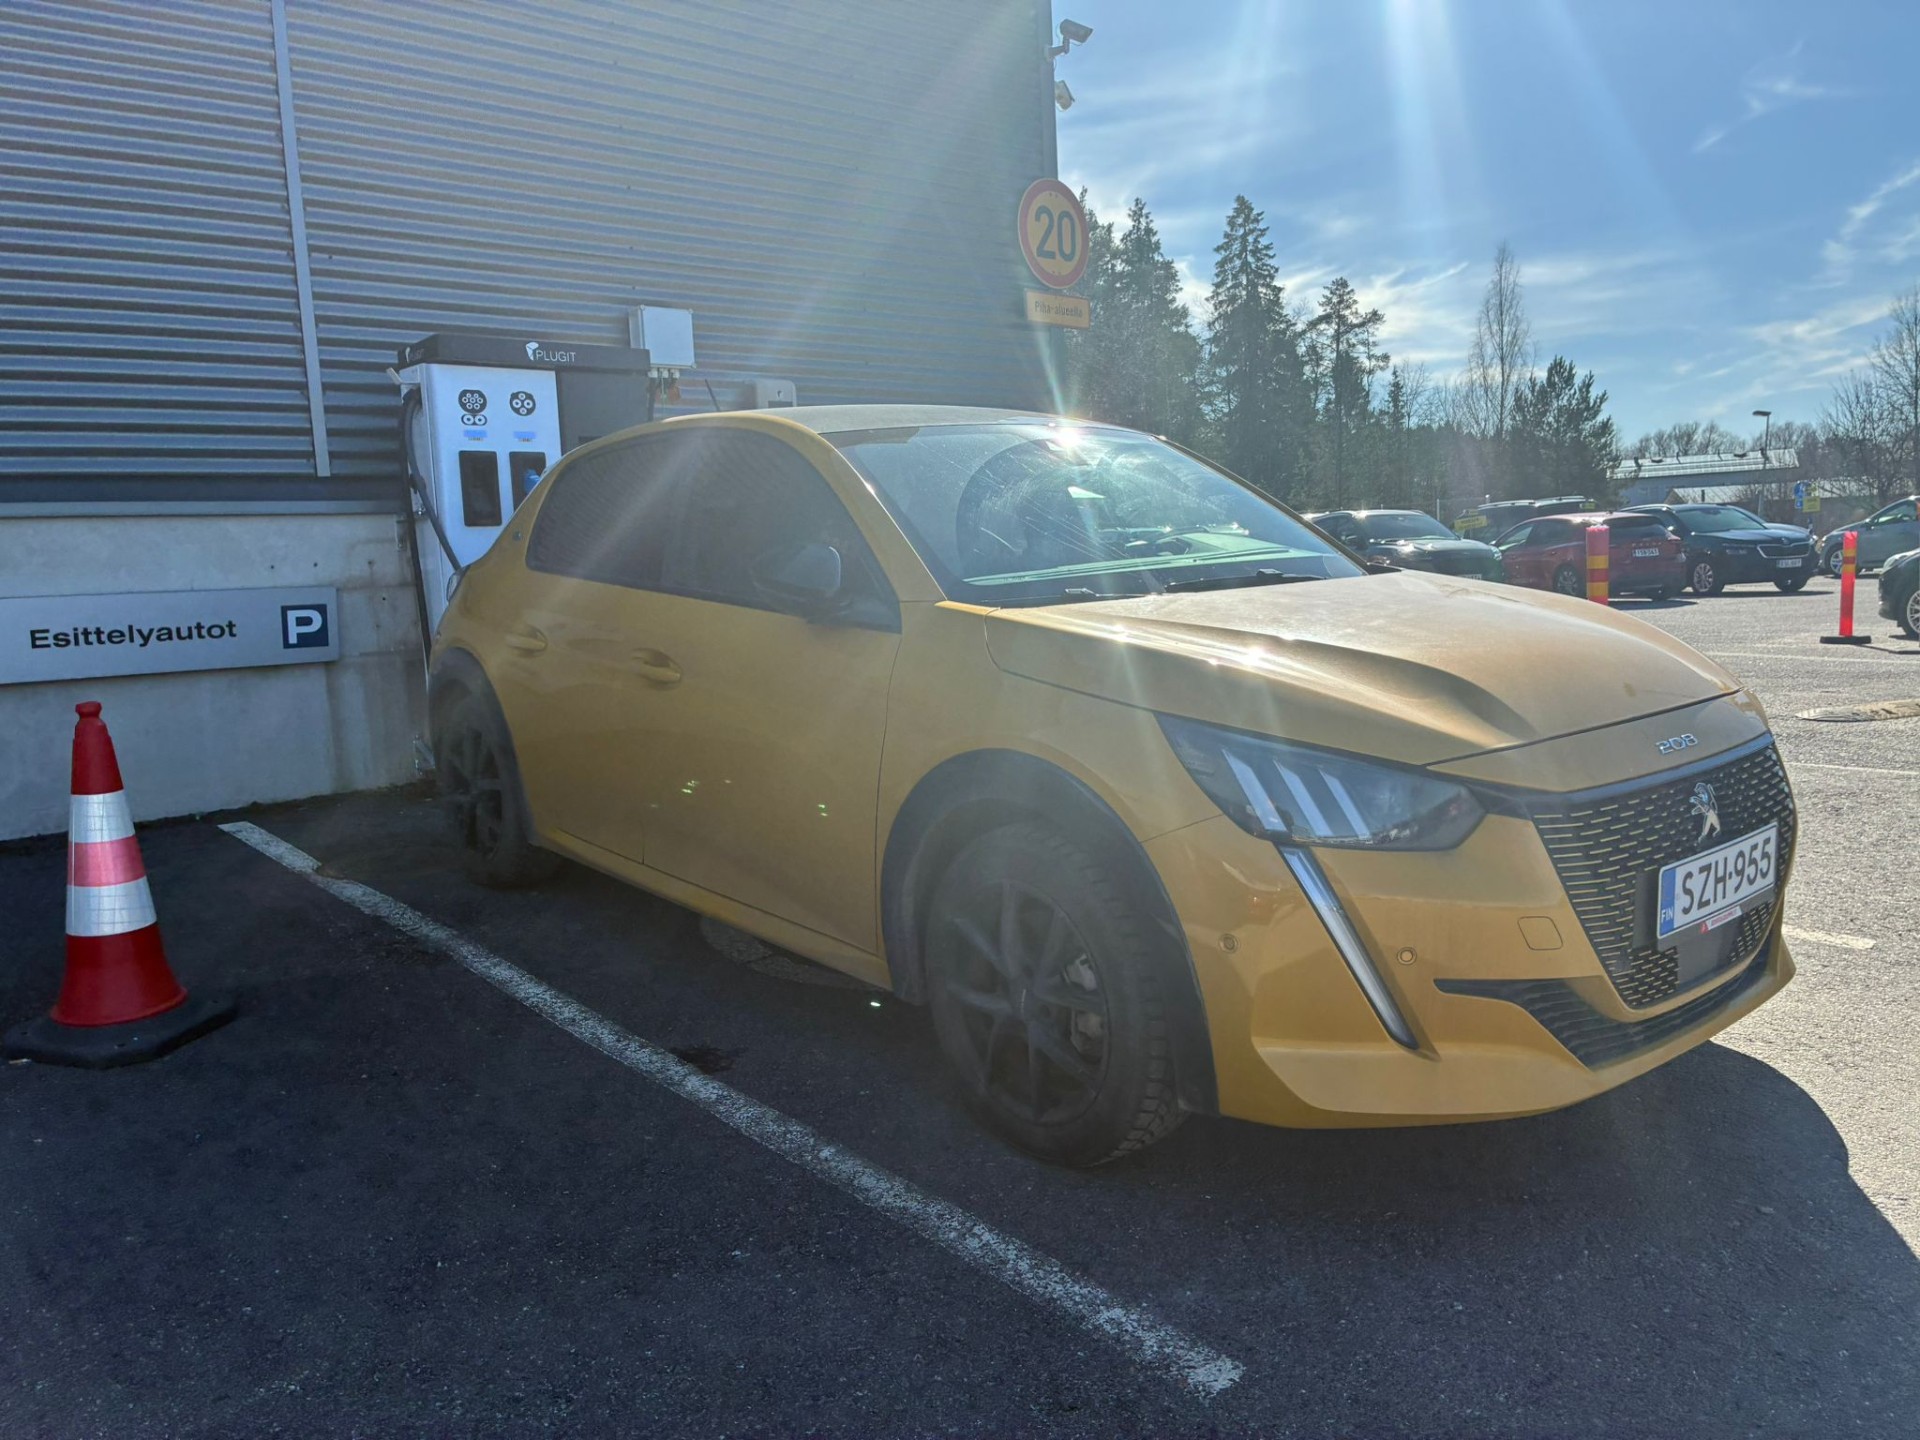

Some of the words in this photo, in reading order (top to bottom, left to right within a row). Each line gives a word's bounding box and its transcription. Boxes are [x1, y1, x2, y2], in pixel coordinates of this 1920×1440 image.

[1034, 204, 1077, 263] 20
[535, 350, 577, 363] PLUGIT
[29, 620, 237, 650] Esittelyautot
[286, 608, 323, 645] P
[1655, 733, 1699, 755] 208
[1681, 836, 1773, 916] SZH-955
[1661, 905, 1675, 926] FIN
